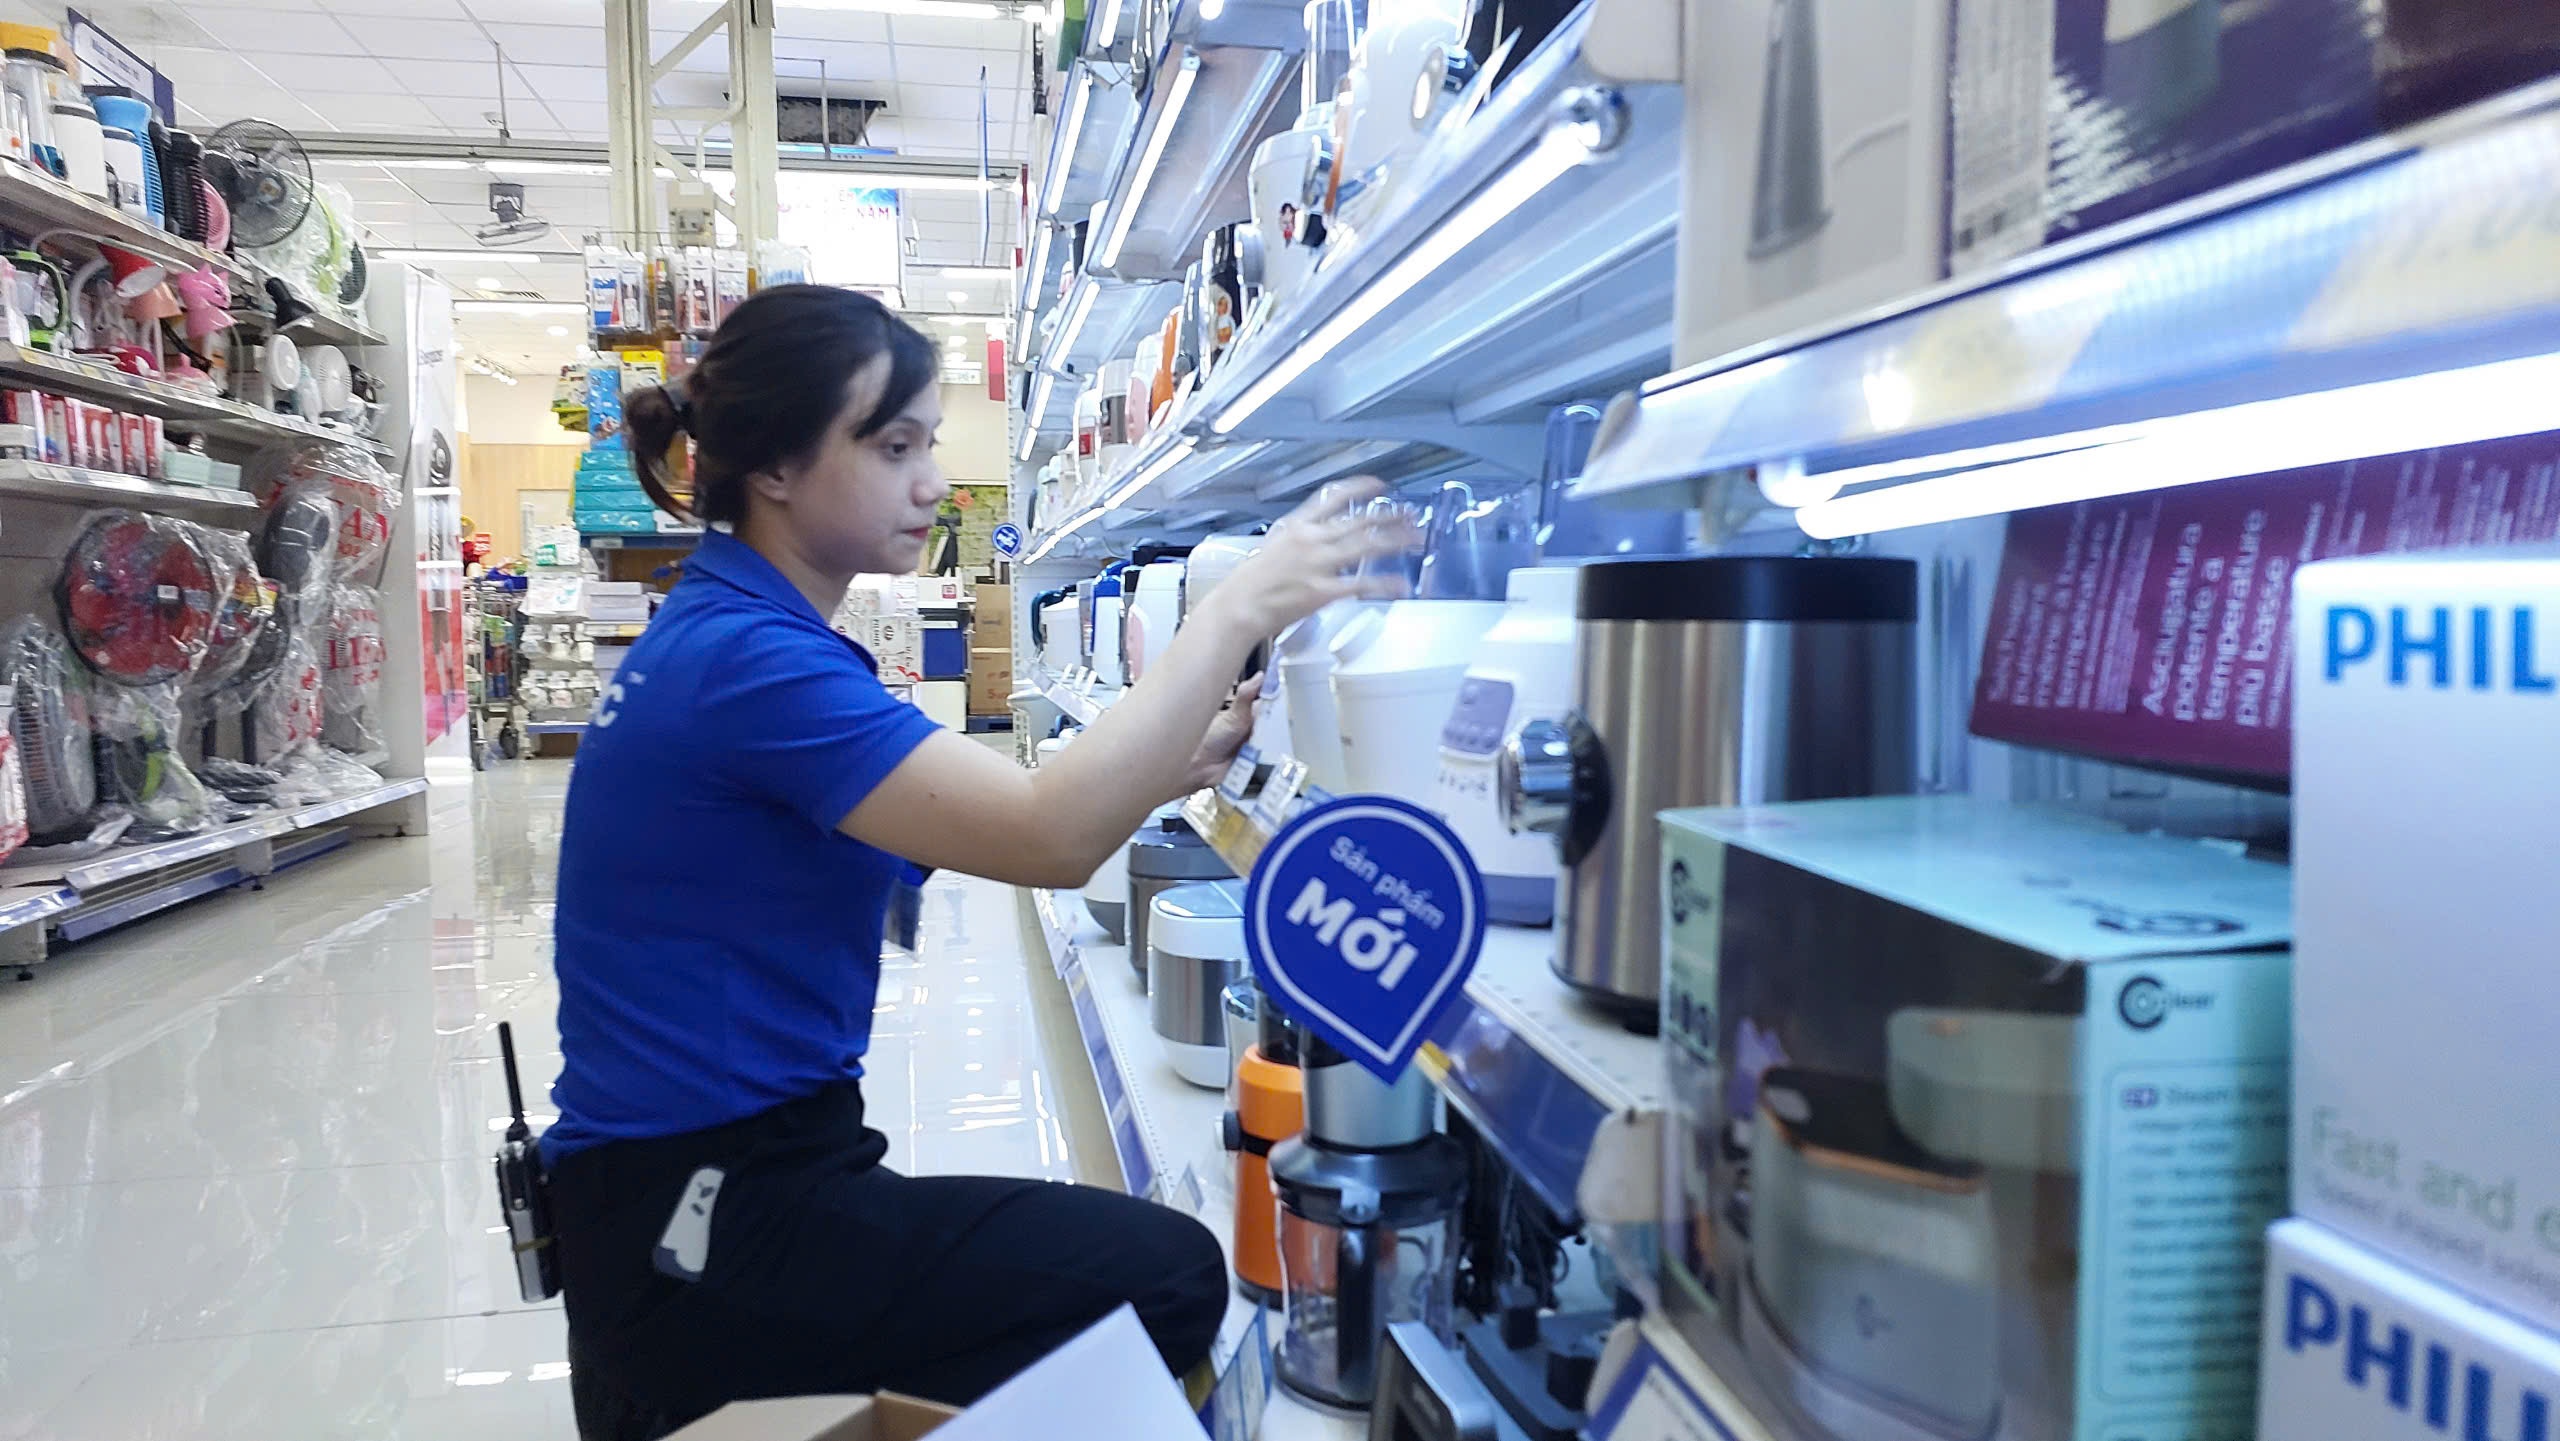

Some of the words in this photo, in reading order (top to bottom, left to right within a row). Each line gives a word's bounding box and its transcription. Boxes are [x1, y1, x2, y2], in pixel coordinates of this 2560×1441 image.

[2174, 588, 2212, 721] potente
[2203, 557, 2224, 581] a
[2203, 508, 2266, 720] temperature
[2243, 557, 2290, 663] basse
[2325, 604, 2554, 690] PHIL
[1329, 836, 1378, 883] Sản
[1373, 872, 1446, 930] phẩm
